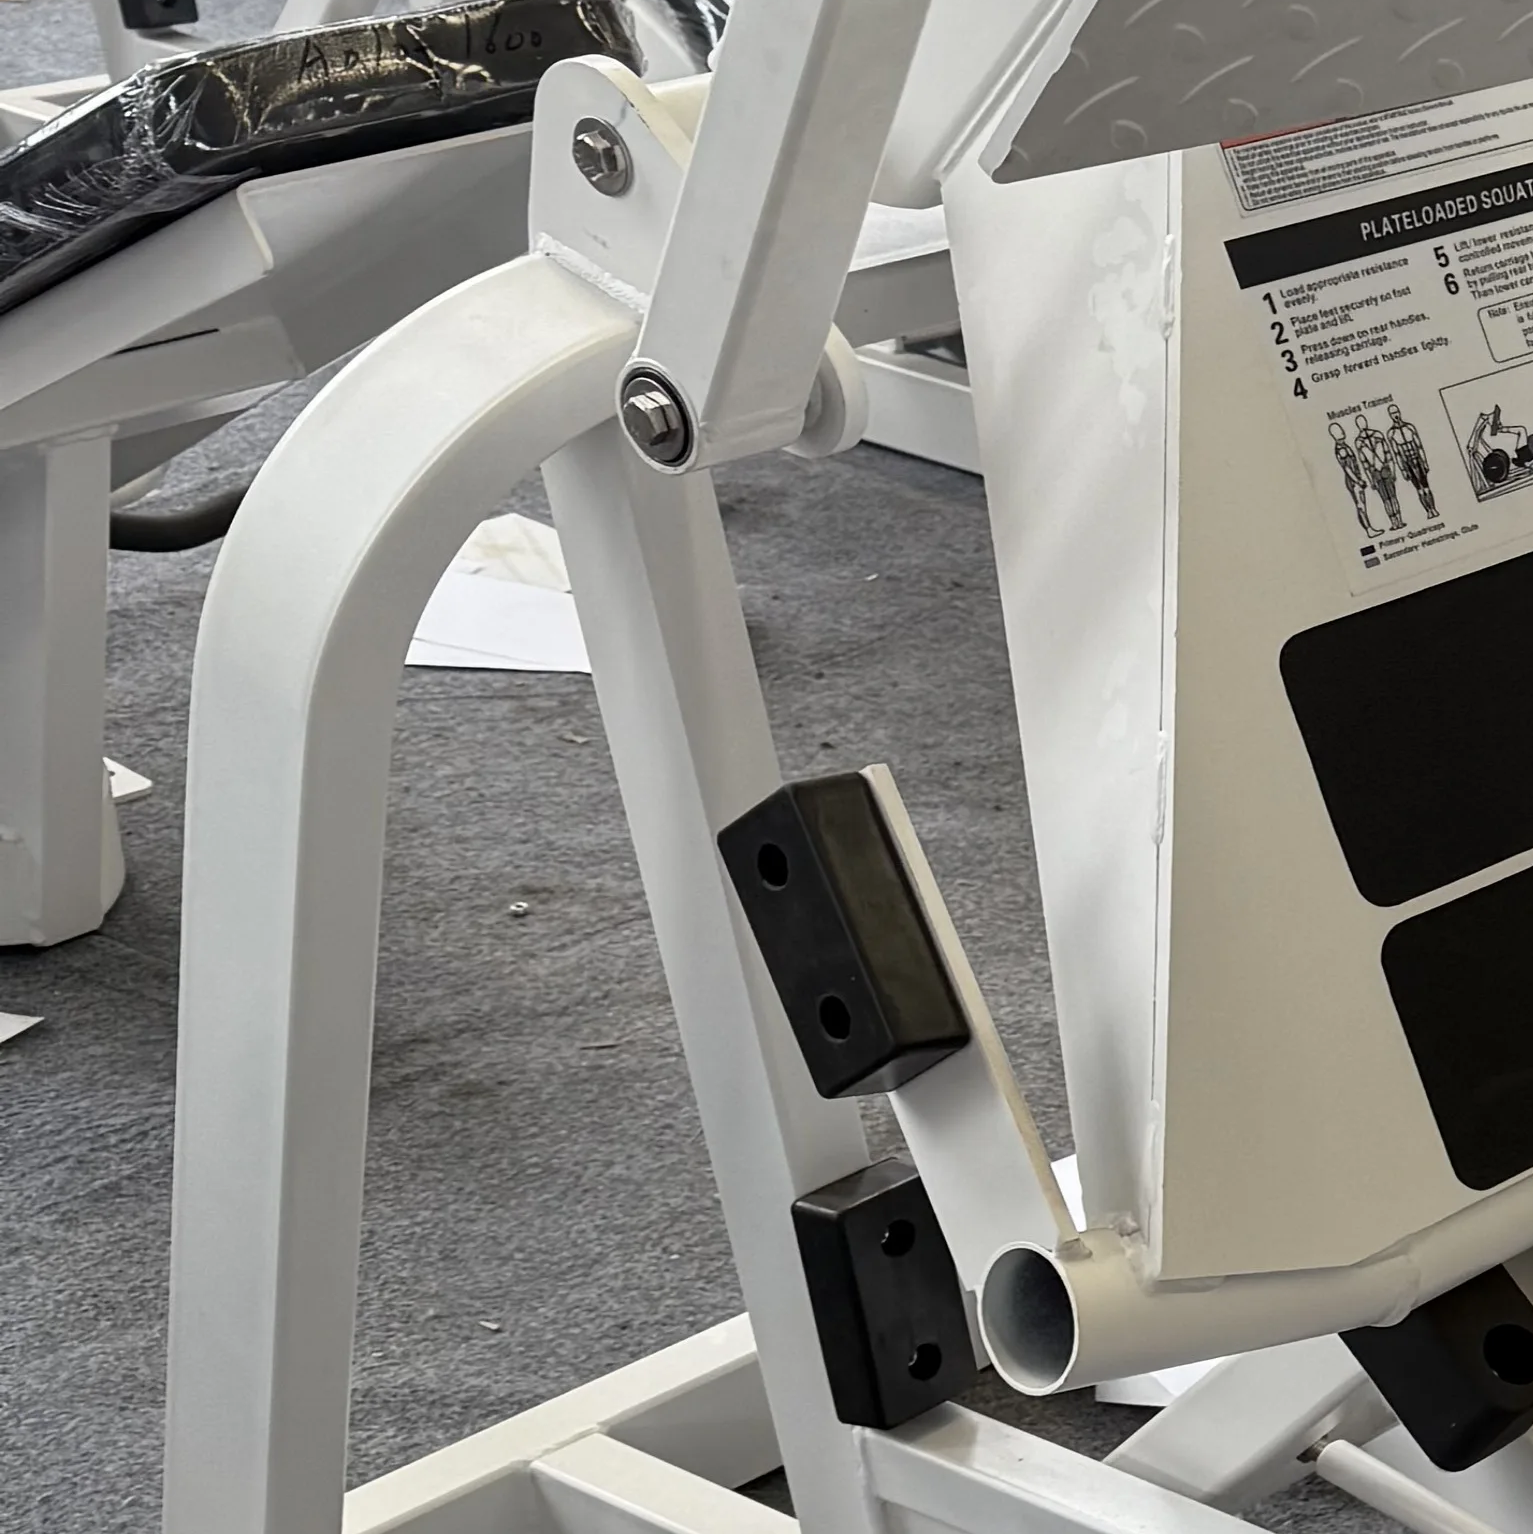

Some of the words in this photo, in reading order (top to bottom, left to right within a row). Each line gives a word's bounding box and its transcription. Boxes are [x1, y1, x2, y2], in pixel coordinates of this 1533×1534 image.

[1360, 194, 1478, 241] PLATELOADED
[1481, 178, 1533, 209] SQUAT
[1433, 246, 1449, 268] 5
[1444, 273, 1460, 295] 6
[1262, 293, 1277, 315] 1
[1271, 322, 1289, 345] 2
[1281, 350, 1298, 372] 3
[1293, 378, 1308, 399] 4
[1327, 404, 1362, 420] Muscles
[1363, 394, 1394, 409] Trained
